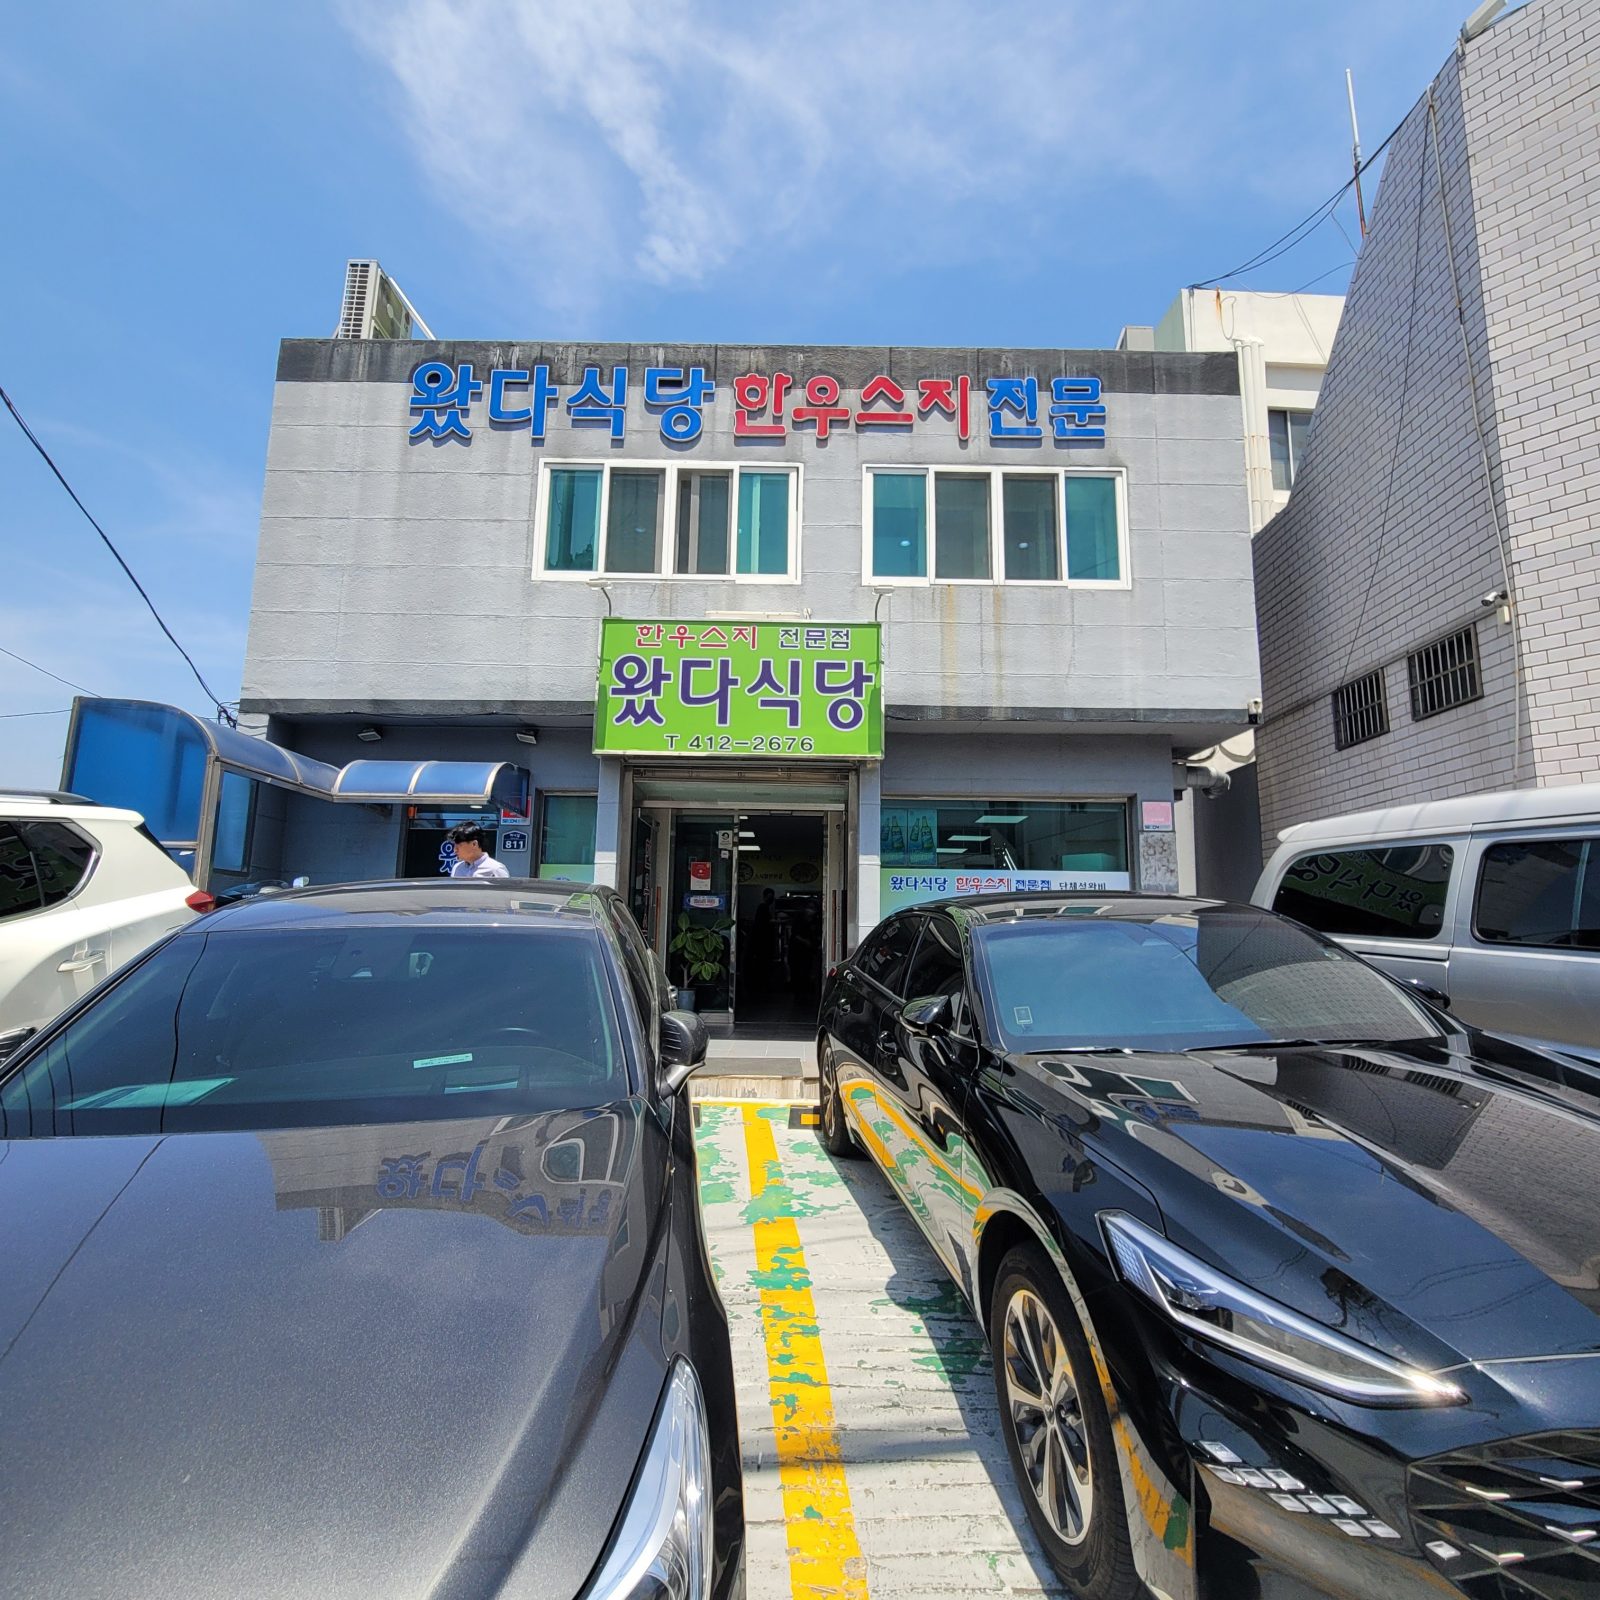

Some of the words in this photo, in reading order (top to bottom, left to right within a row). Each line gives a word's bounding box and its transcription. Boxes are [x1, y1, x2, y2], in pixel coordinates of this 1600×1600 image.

[409, 361, 715, 442] 왔다식당
[732, 373, 970, 441] 한우스지
[986, 376, 1107, 441] 전문
[635, 624, 758, 650] 한우스지
[779, 628, 851, 650] 전문점
[609, 653, 875, 731] 왔다식당
[664, 734, 681, 749] T
[688, 734, 815, 751] 412-2676
[506, 840, 523, 849] 811
[890, 876, 949, 892] 왔다식당
[955, 877, 1012, 892] 한우스지
[1015, 879, 1052, 891] 전문점
